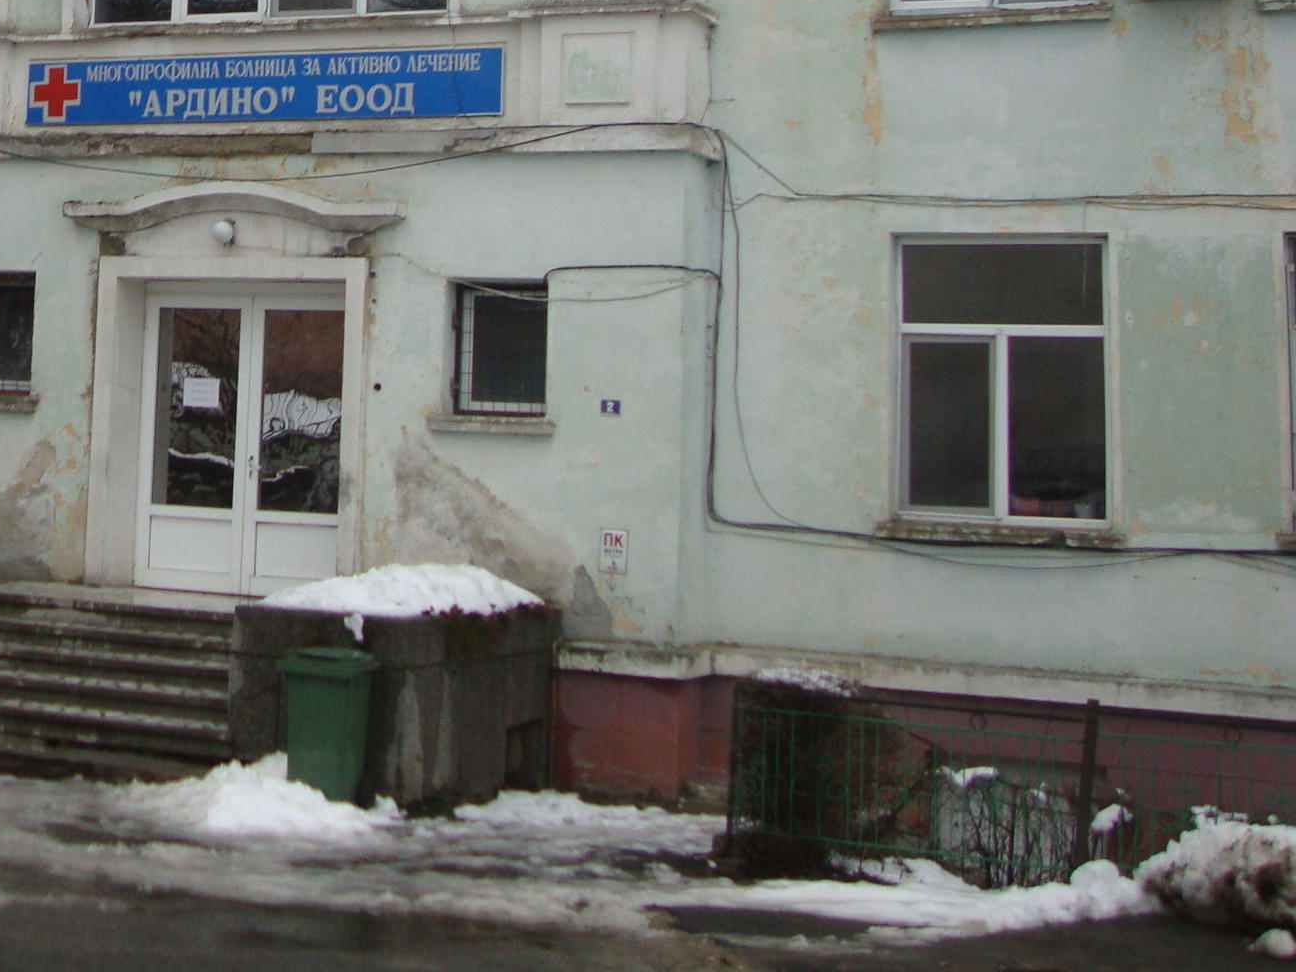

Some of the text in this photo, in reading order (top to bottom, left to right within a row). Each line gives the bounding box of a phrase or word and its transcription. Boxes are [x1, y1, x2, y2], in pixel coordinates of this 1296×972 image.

[87, 53, 481, 82] МНОГОПРОФИЛНА БОЛНИЦА ЗА АКТИВНО ЛЕЧЕНИЕ
[128, 82, 415, 120] "АРДИНО" ЕООД
[604, 532, 624, 548] ПК
